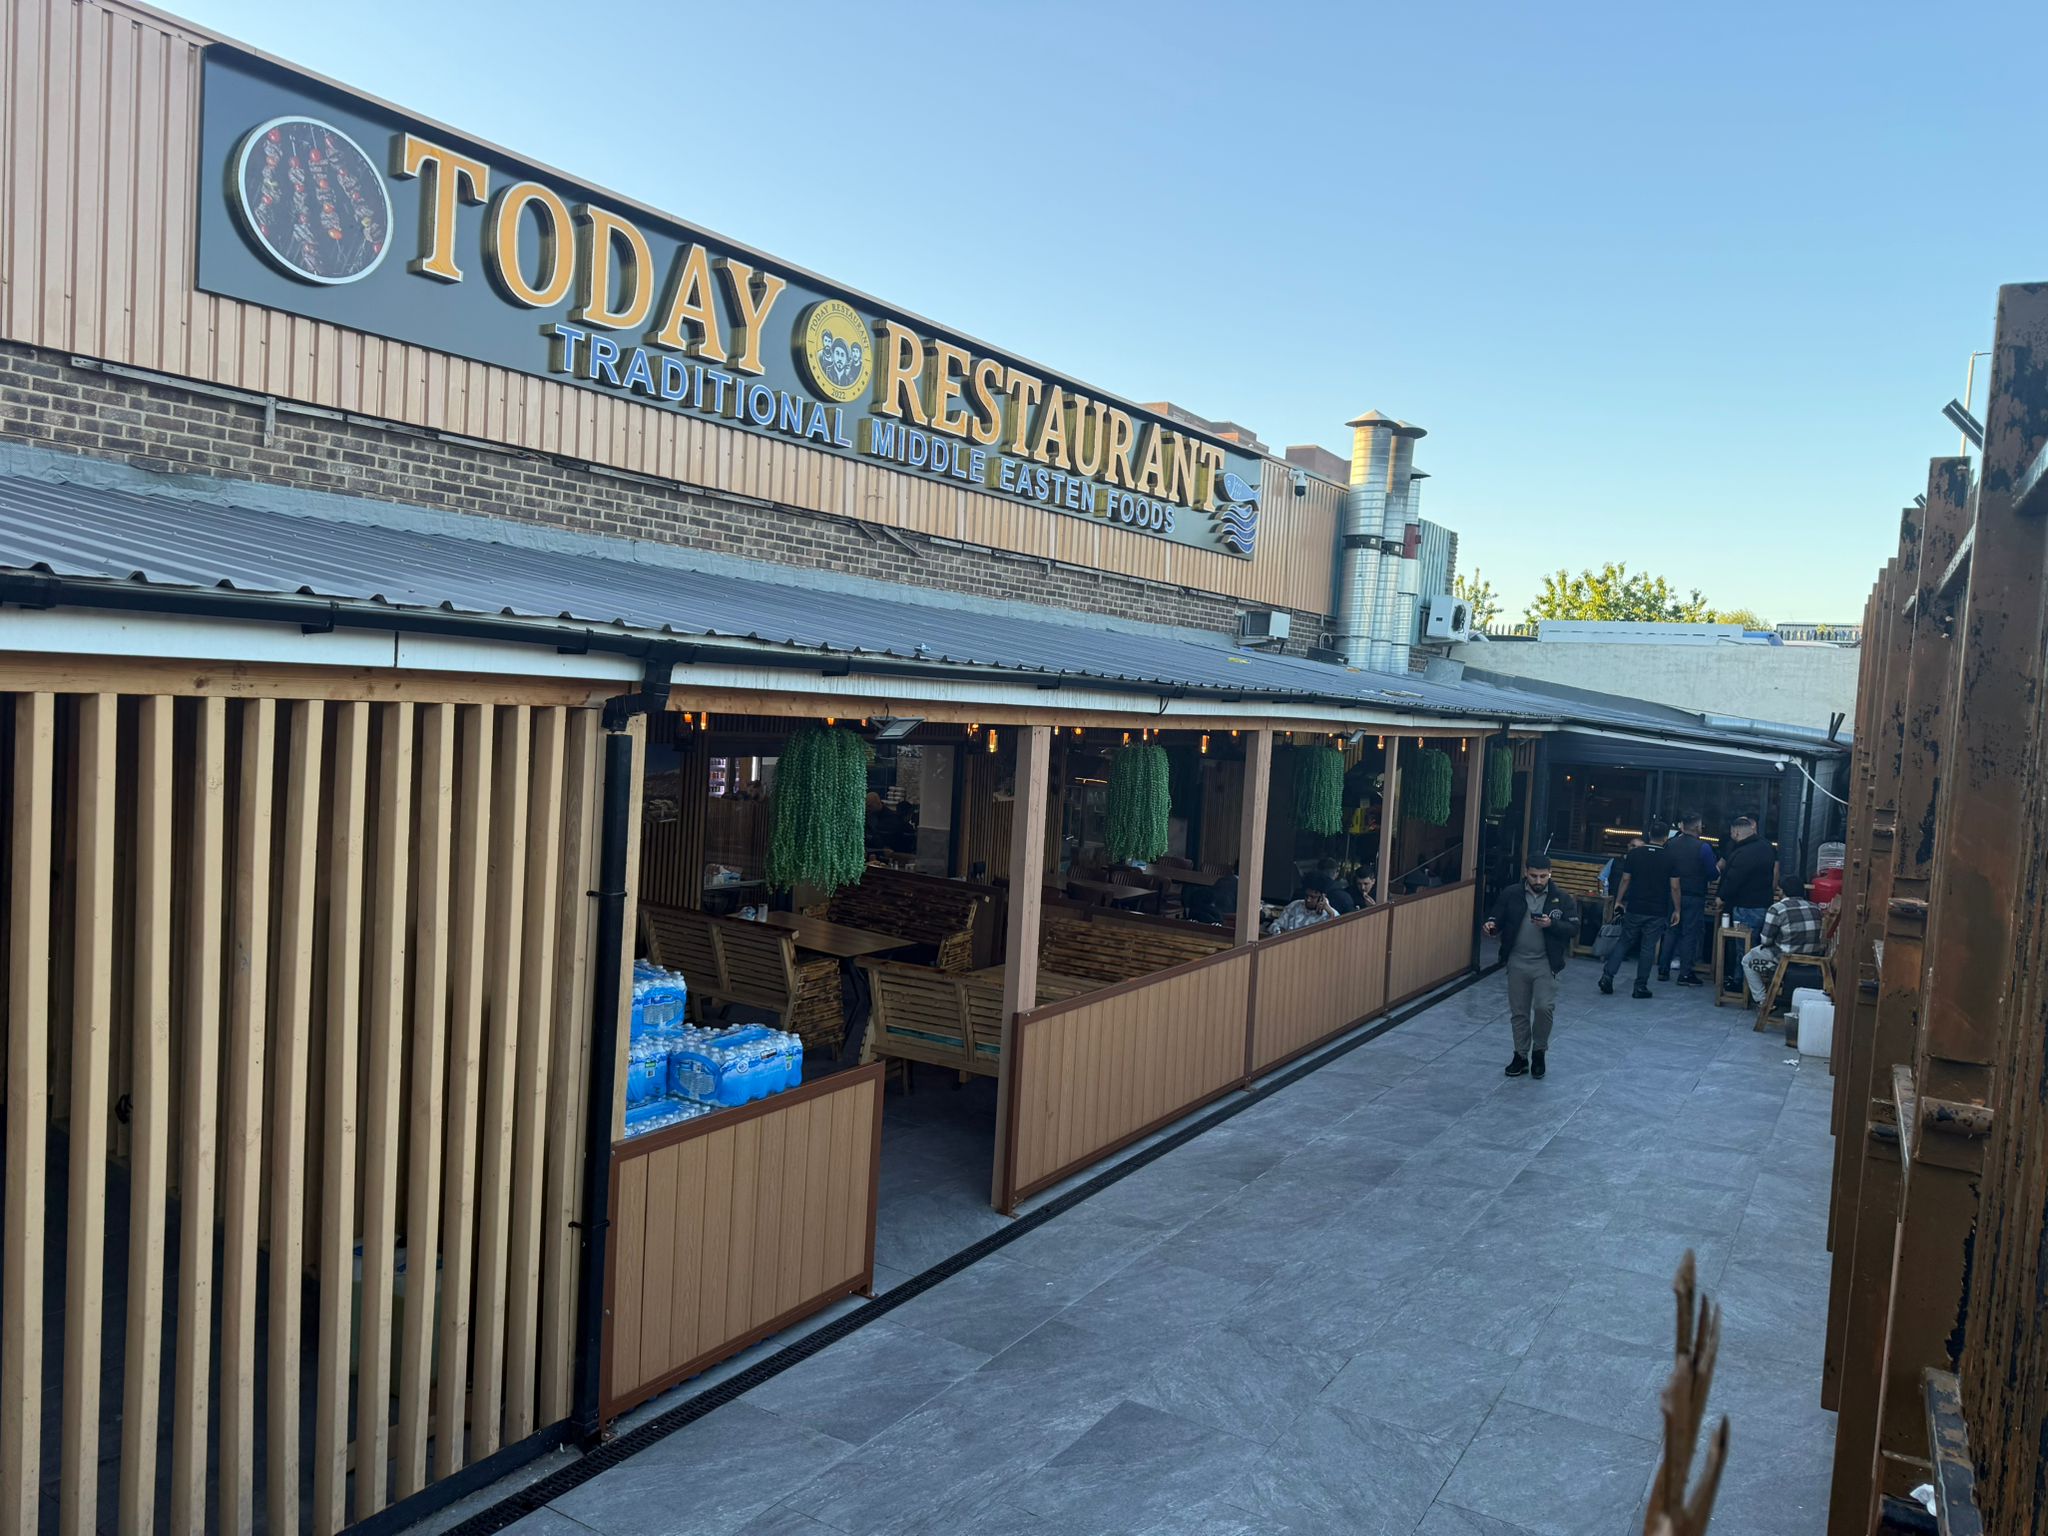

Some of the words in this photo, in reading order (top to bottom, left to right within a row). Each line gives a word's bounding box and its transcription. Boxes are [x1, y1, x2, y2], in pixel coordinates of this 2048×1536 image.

[402, 132, 787, 376] TODAY
[882, 319, 1225, 512] RESTAURANT
[810, 304, 828, 332] TODAY
[831, 303, 870, 351] RESTAURANT
[555, 323, 852, 448] TRADITIONAL
[871, 418, 985, 484] MIDDLE
[1000, 457, 1096, 512] EASTEN
[1107, 489, 1176, 534] FOODS
[831, 388, 846, 400] 2022
